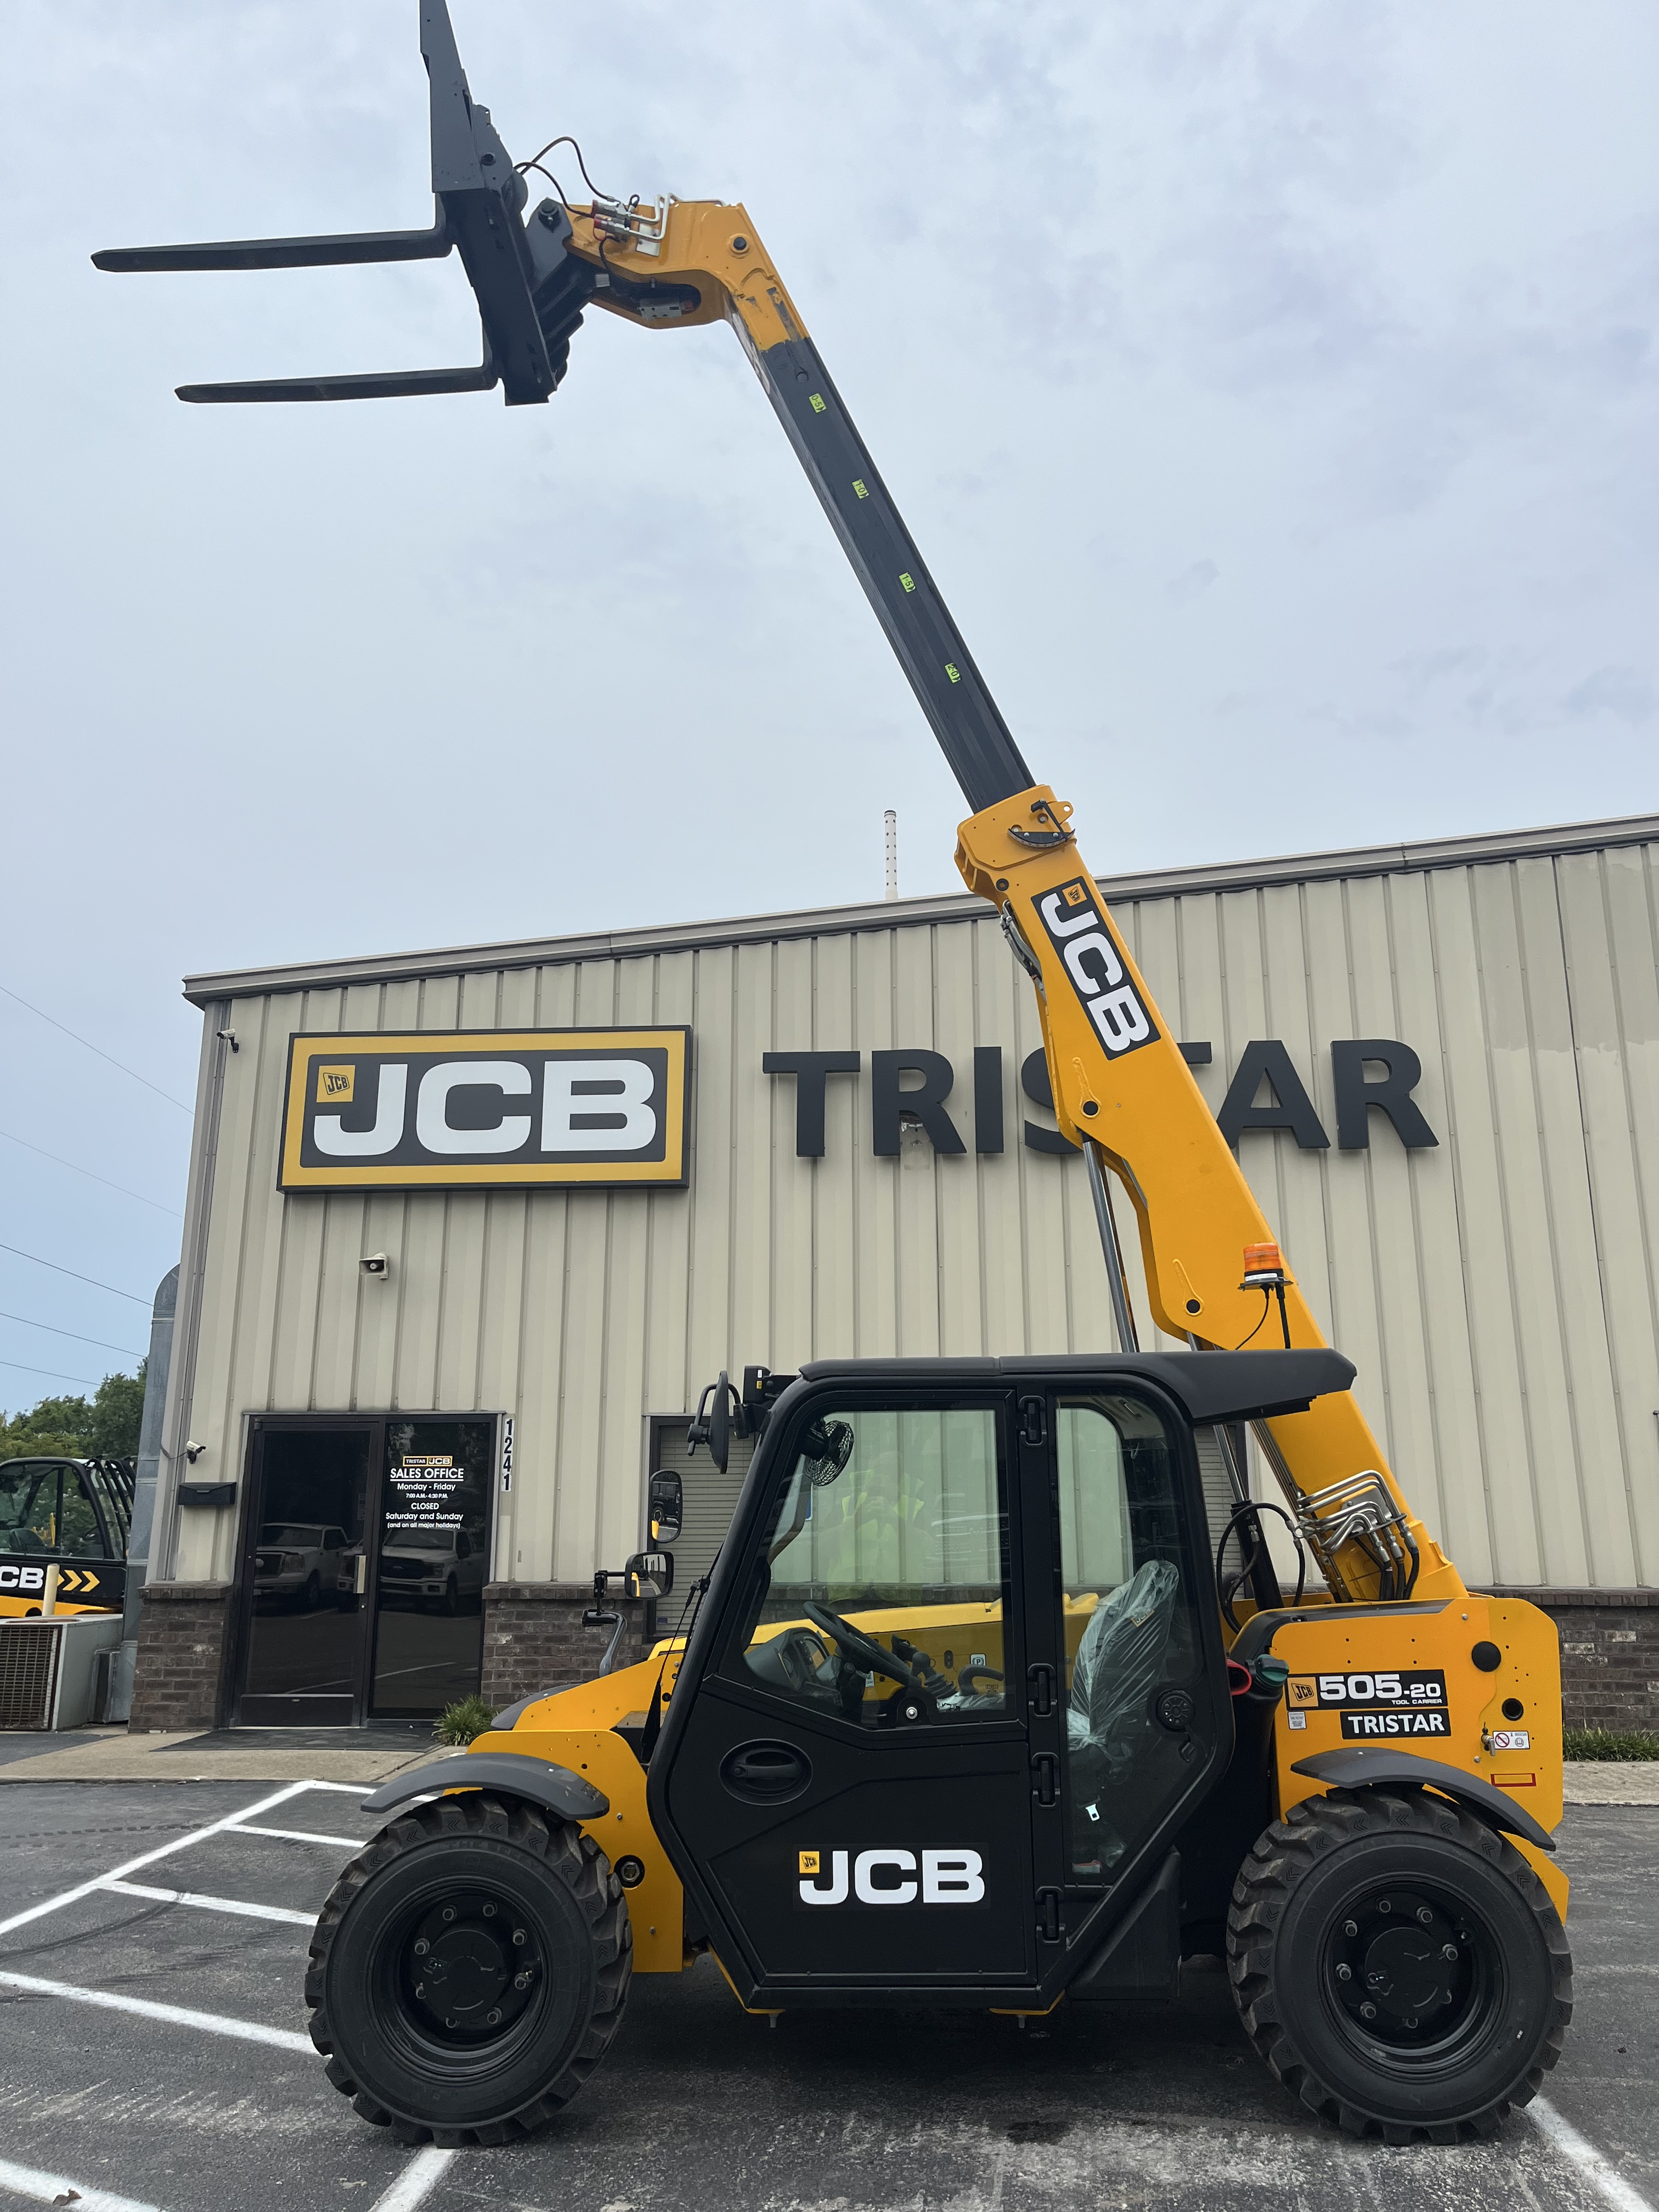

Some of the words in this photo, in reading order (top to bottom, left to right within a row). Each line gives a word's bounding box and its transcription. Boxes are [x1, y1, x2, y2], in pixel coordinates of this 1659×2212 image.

[1041, 893, 1149, 1052] JCB
[327, 1075, 348, 1092] JCB
[313, 1059, 656, 1156] JCB
[763, 1039, 1440, 1158] TRIAR
[503, 1419, 512, 1491] 1241
[390, 1468, 421, 1479] SALES
[424, 1468, 464, 1479] OFFICE
[397, 1483, 427, 1491] Monday
[433, 1483, 456, 1491] Friday
[386, 1512, 418, 1521] Saturday
[436, 1513, 464, 1521] Sunday
[1295, 1685, 1312, 1700] JCB
[1319, 1674, 1441, 1700] 505-20
[1347, 1713, 1445, 1734] TRISTAR
[804, 1857, 817, 1868] JCB
[799, 1849, 985, 1905] JCB
